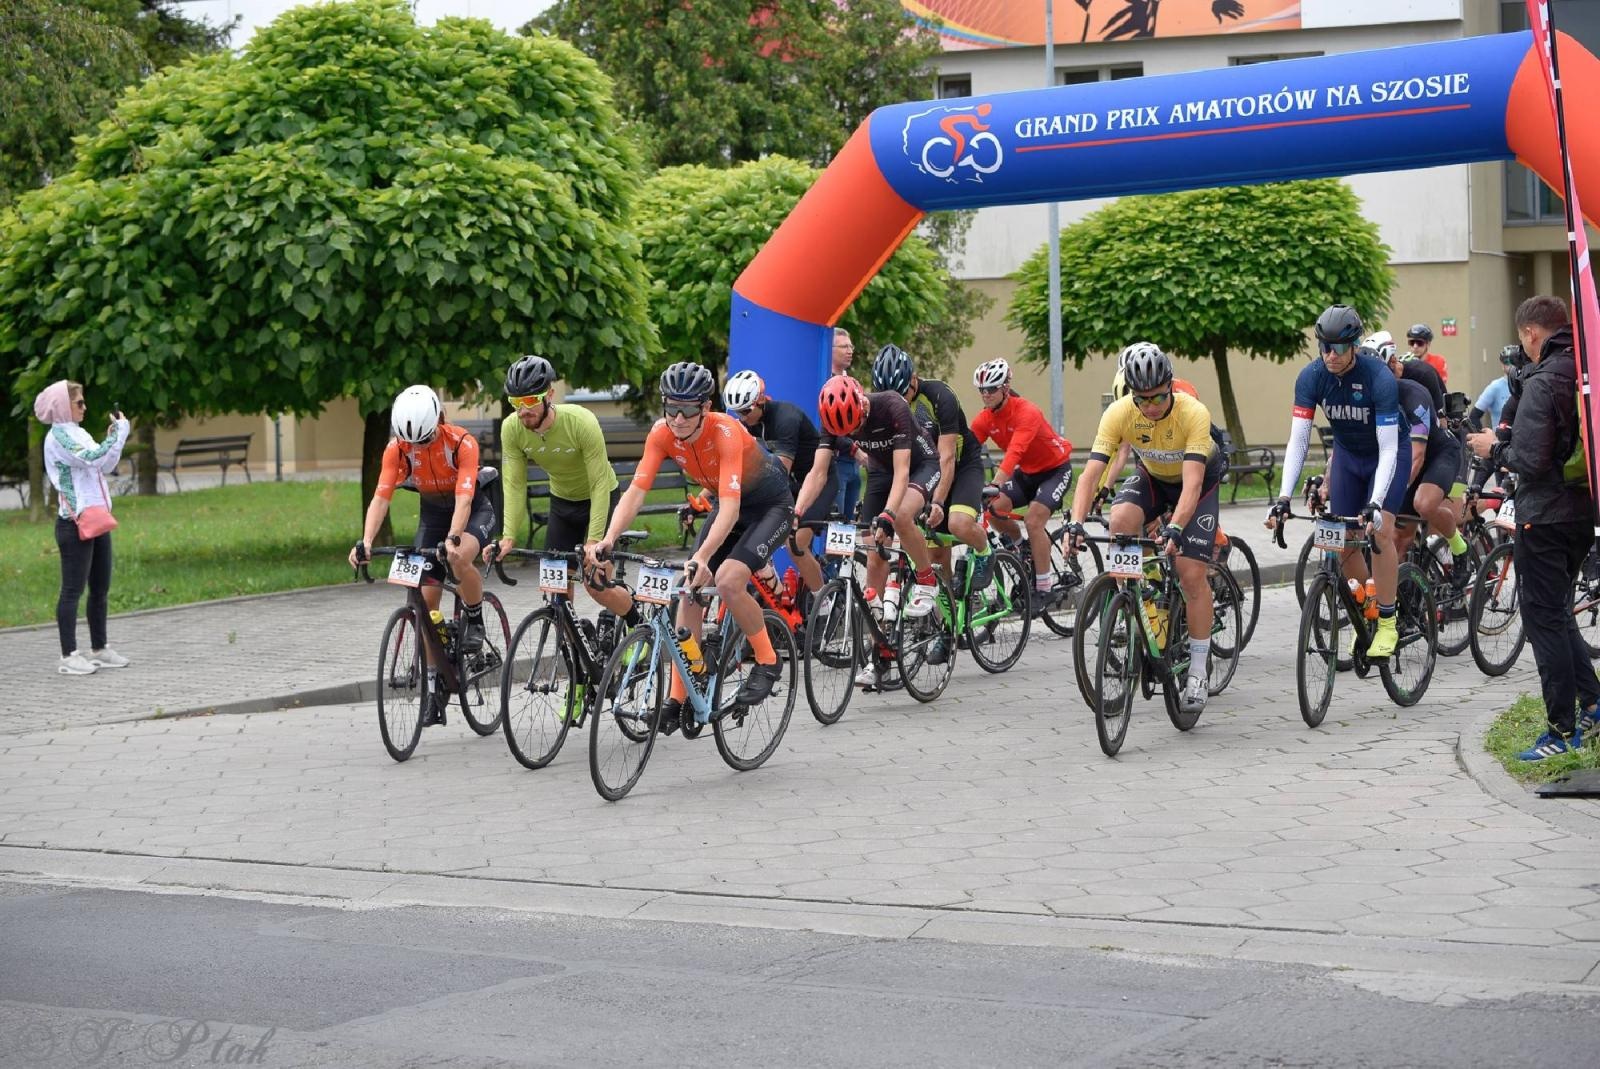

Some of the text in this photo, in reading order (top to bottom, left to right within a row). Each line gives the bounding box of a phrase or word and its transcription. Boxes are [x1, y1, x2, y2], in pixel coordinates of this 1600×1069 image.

[1014, 72, 1470, 138] GRAND PRIX AMATORÓW NA SZOSIE
[830, 532, 853, 545] 215
[1318, 528, 1342, 541] 191
[1113, 554, 1139, 567] 028
[541, 567, 565, 582] 133
[642, 574, 669, 591] 218
